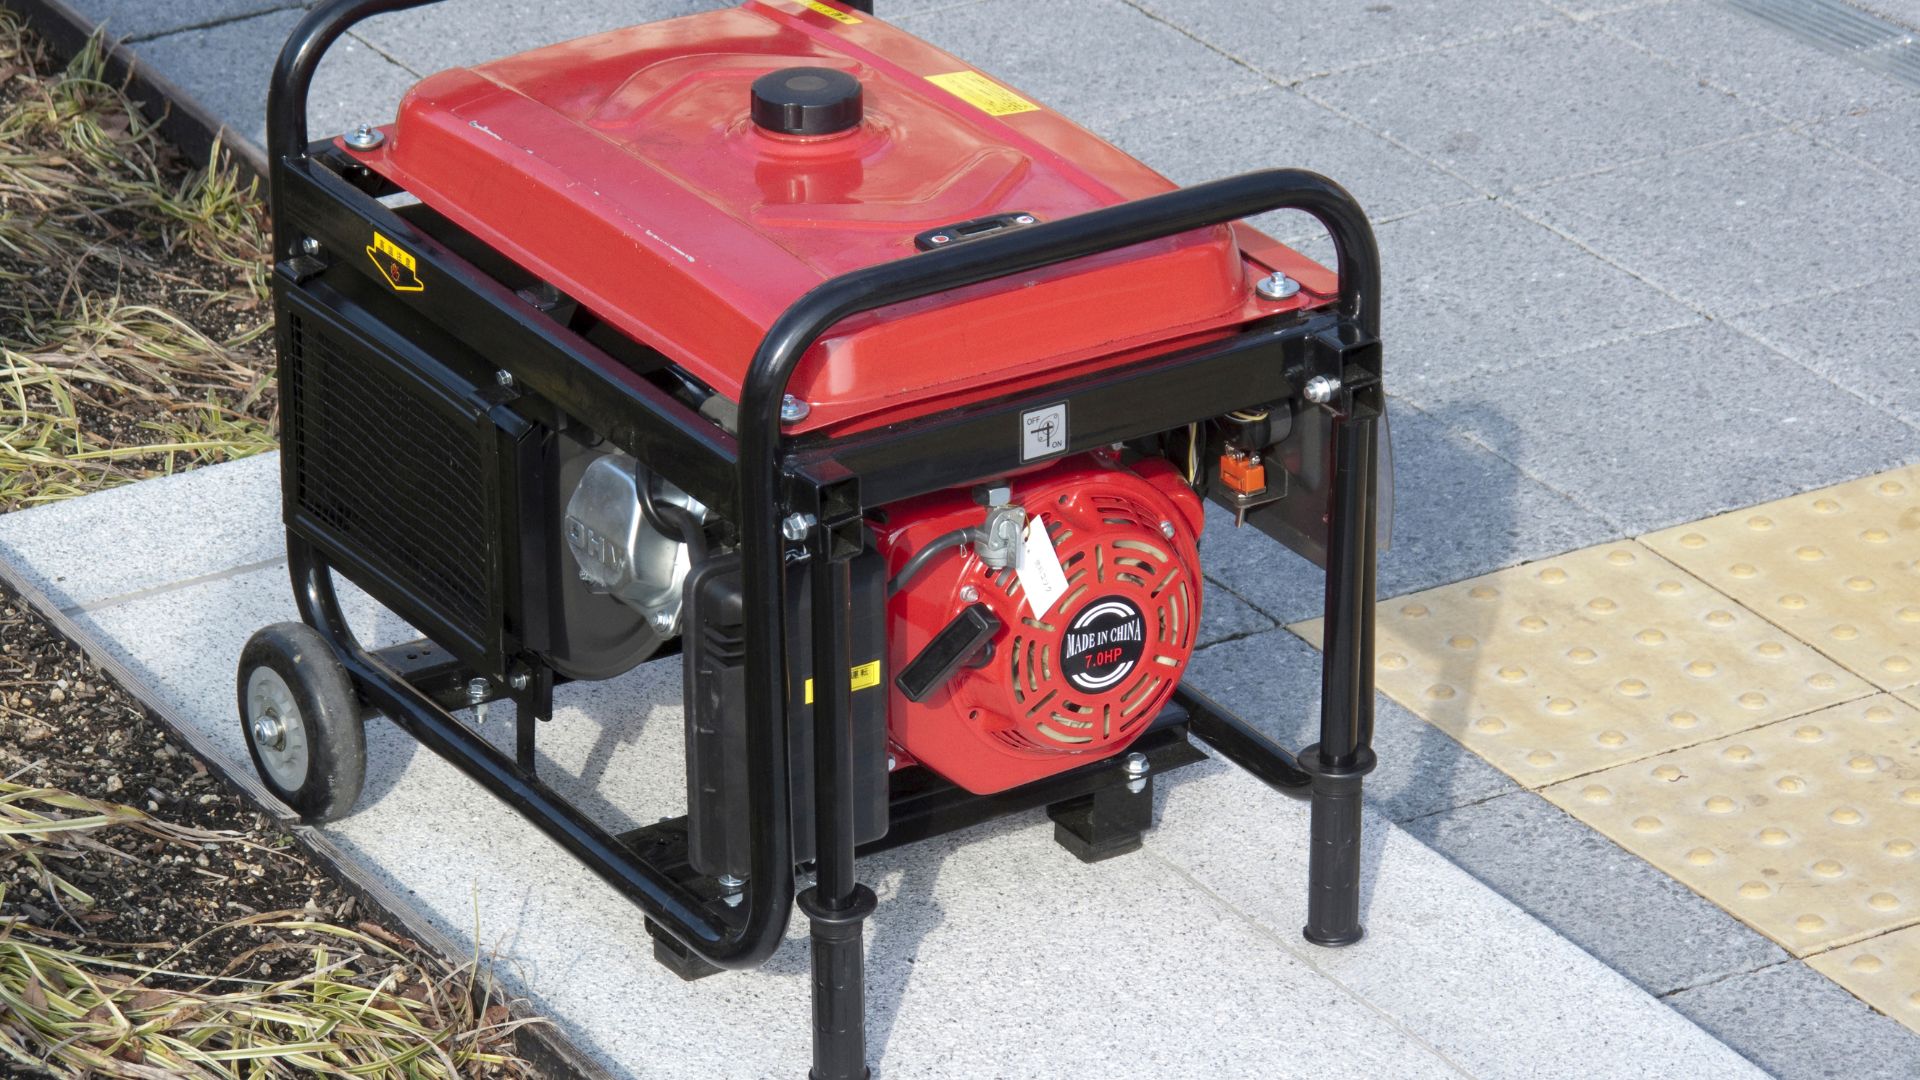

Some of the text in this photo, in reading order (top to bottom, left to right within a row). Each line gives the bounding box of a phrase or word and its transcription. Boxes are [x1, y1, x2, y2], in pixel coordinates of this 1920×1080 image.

[1027, 416, 1040, 425] OFF
[1052, 440, 1062, 448] ON
[1066, 617, 1141, 659] MADE IN CHINA
[1085, 647, 1122, 669] 7.0HP
